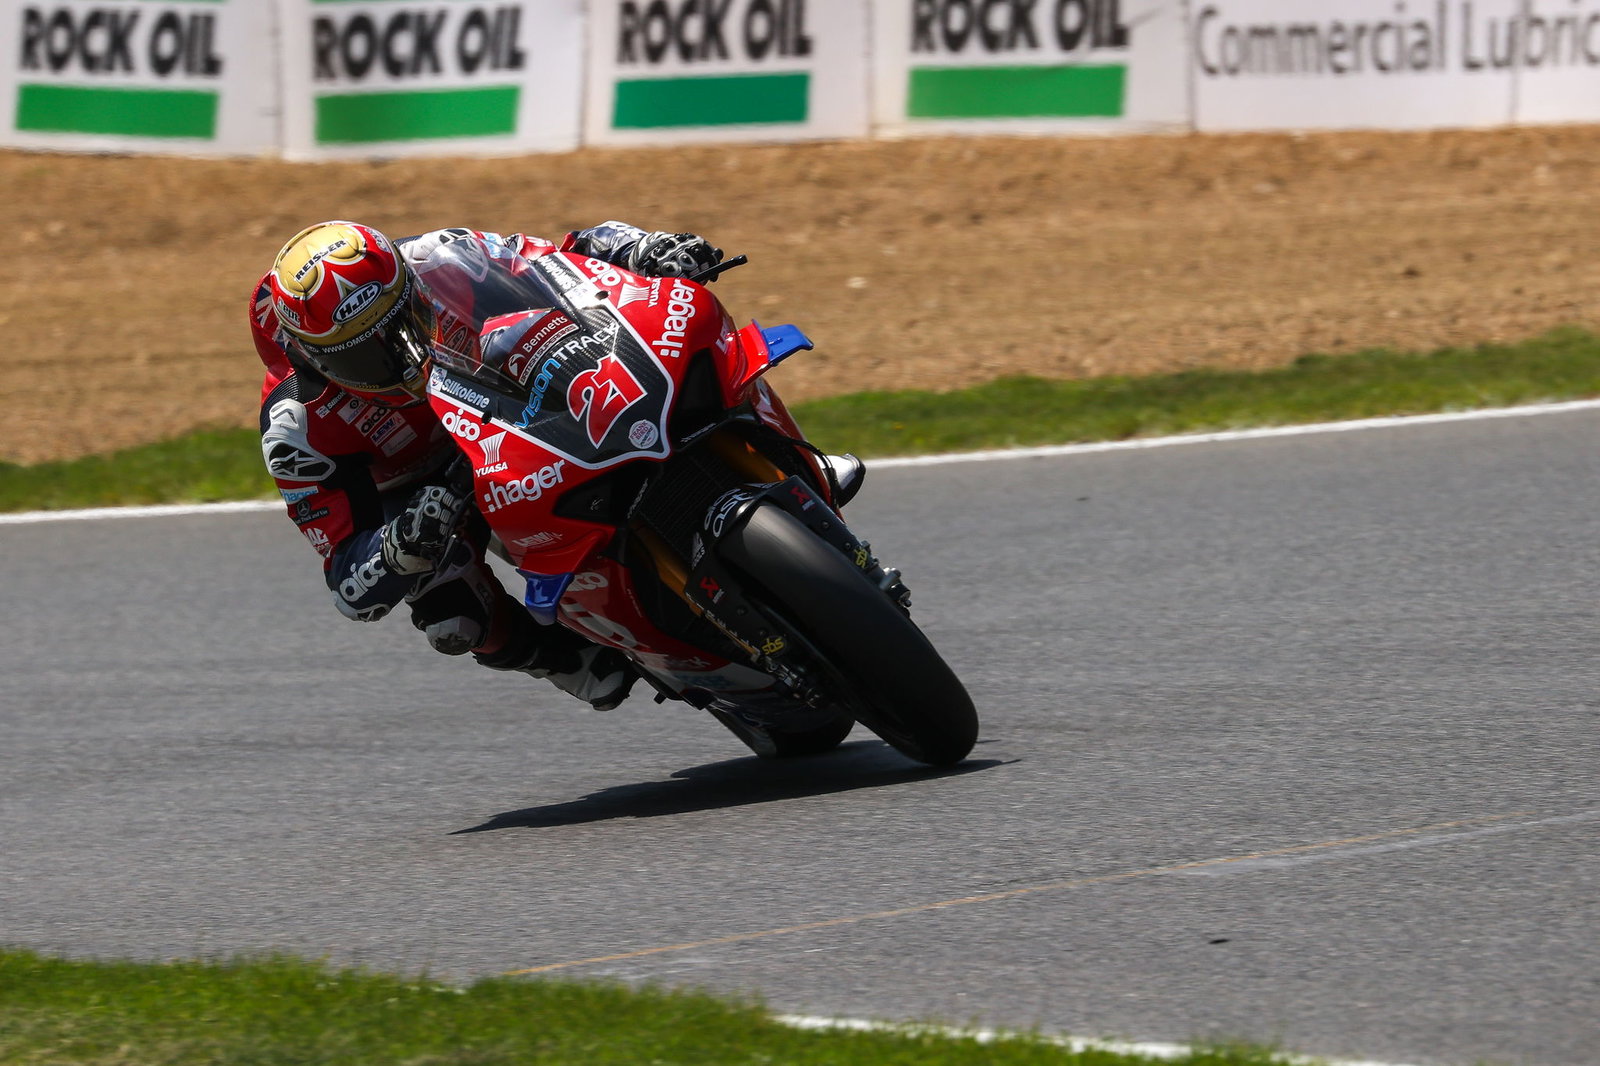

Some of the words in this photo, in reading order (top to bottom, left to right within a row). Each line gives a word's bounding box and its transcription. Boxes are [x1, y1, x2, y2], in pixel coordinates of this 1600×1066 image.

[20, 8, 139, 74] ROCK
[150, 10, 222, 76] OIL
[312, 10, 448, 82] ROCK
[457, 7, 527, 76] OIL
[616, 0, 735, 64] ROCK
[743, 0, 813, 60] OIL
[910, 0, 1041, 53] ROCK
[1054, 0, 1130, 52] OIL
[1199, 0, 1447, 77] Commercial
[294, 239, 347, 281] REISSER
[338, 286, 376, 320] HJC
[522, 315, 568, 354] Bennetts
[442, 378, 490, 409] Silkolene
[567, 353, 648, 449] 21
[475, 462, 509, 478] YUASA
